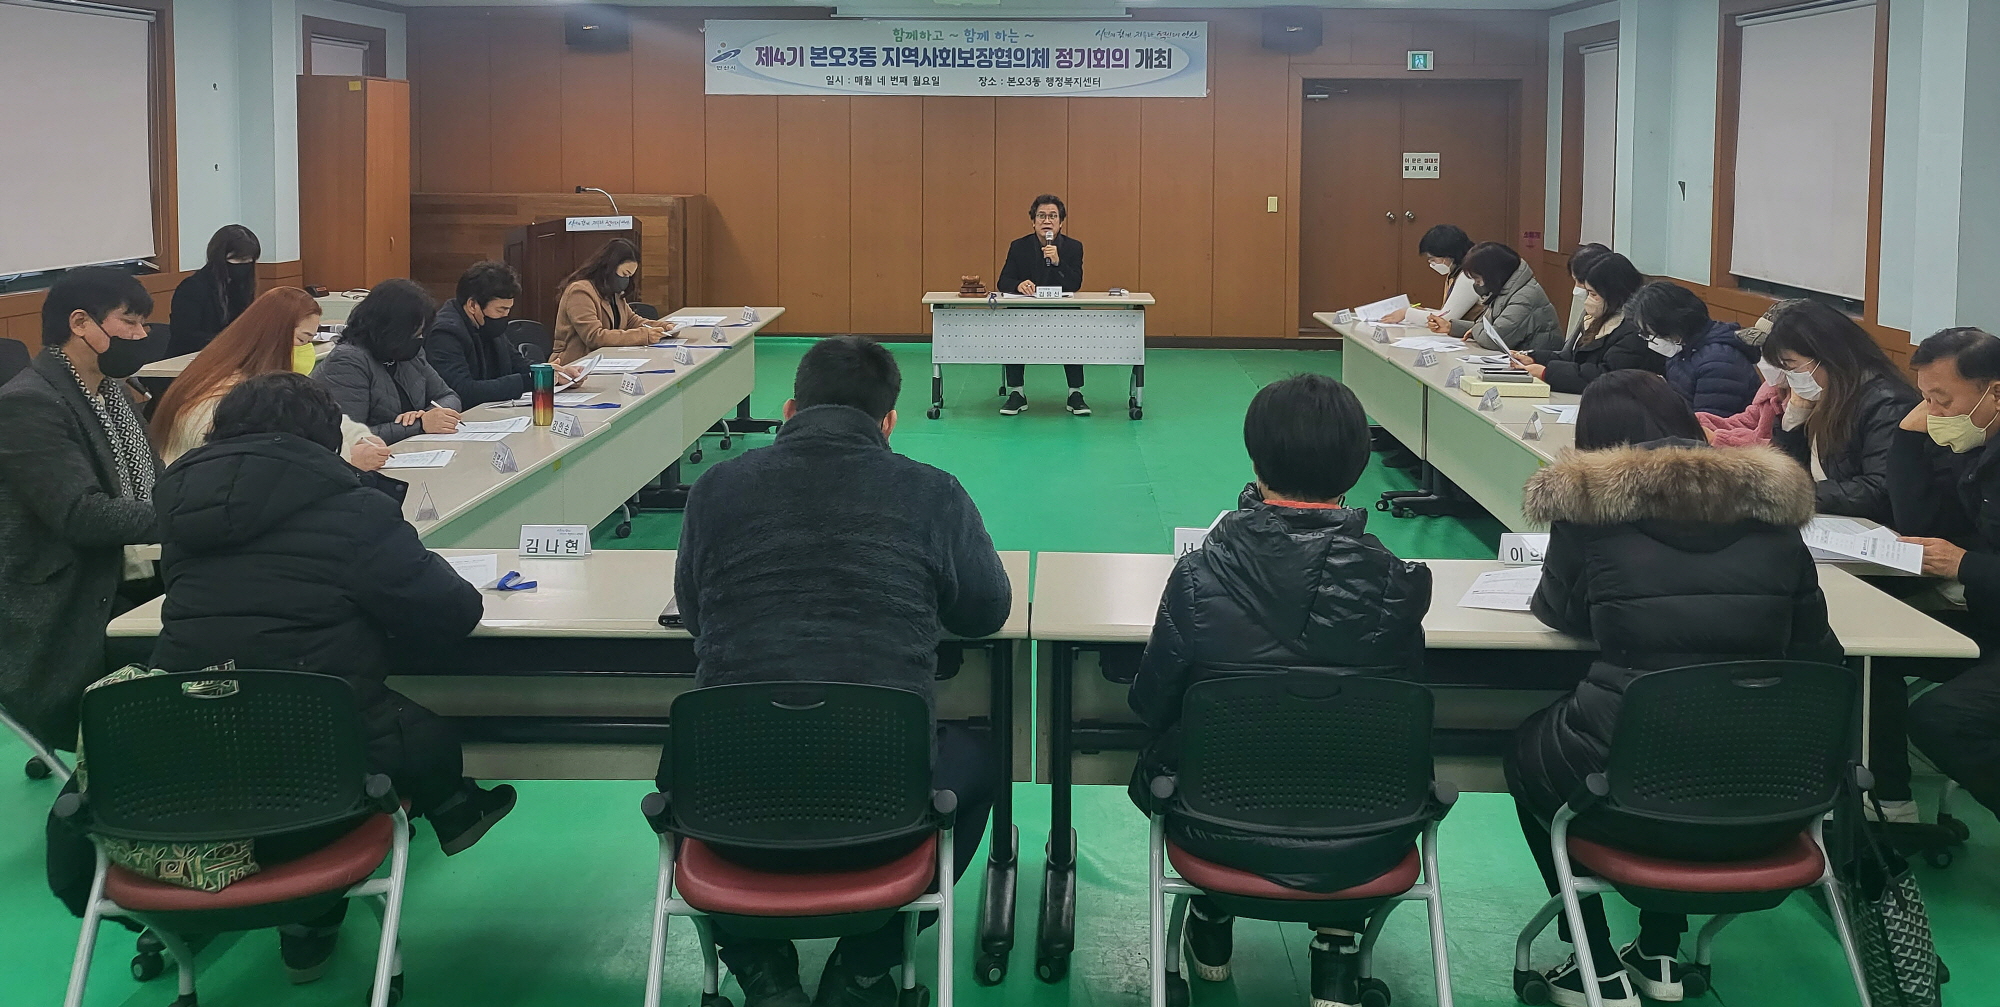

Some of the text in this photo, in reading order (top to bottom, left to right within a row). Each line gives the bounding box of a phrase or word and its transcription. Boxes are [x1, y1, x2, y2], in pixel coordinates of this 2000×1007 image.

[892, 28, 944, 42] 함께하고
[964, 28, 989, 43] 함께
[994, 29, 1020, 43] 하는
[755, 46, 1172, 69] 제4기 본오3동 지역사회보장협의체 정기회의 개최
[826, 75, 844, 86] 일시
[854, 75, 873, 86] 매월
[877, 75, 886, 86] 네
[890, 75, 908, 86] 번째
[912, 76, 940, 86] 월요일
[978, 76, 997, 86] 장소
[1006, 76, 1041, 87] 본오3동
[1045, 76, 1101, 87] 행정복지센터
[525, 538, 579, 554] 김나현
